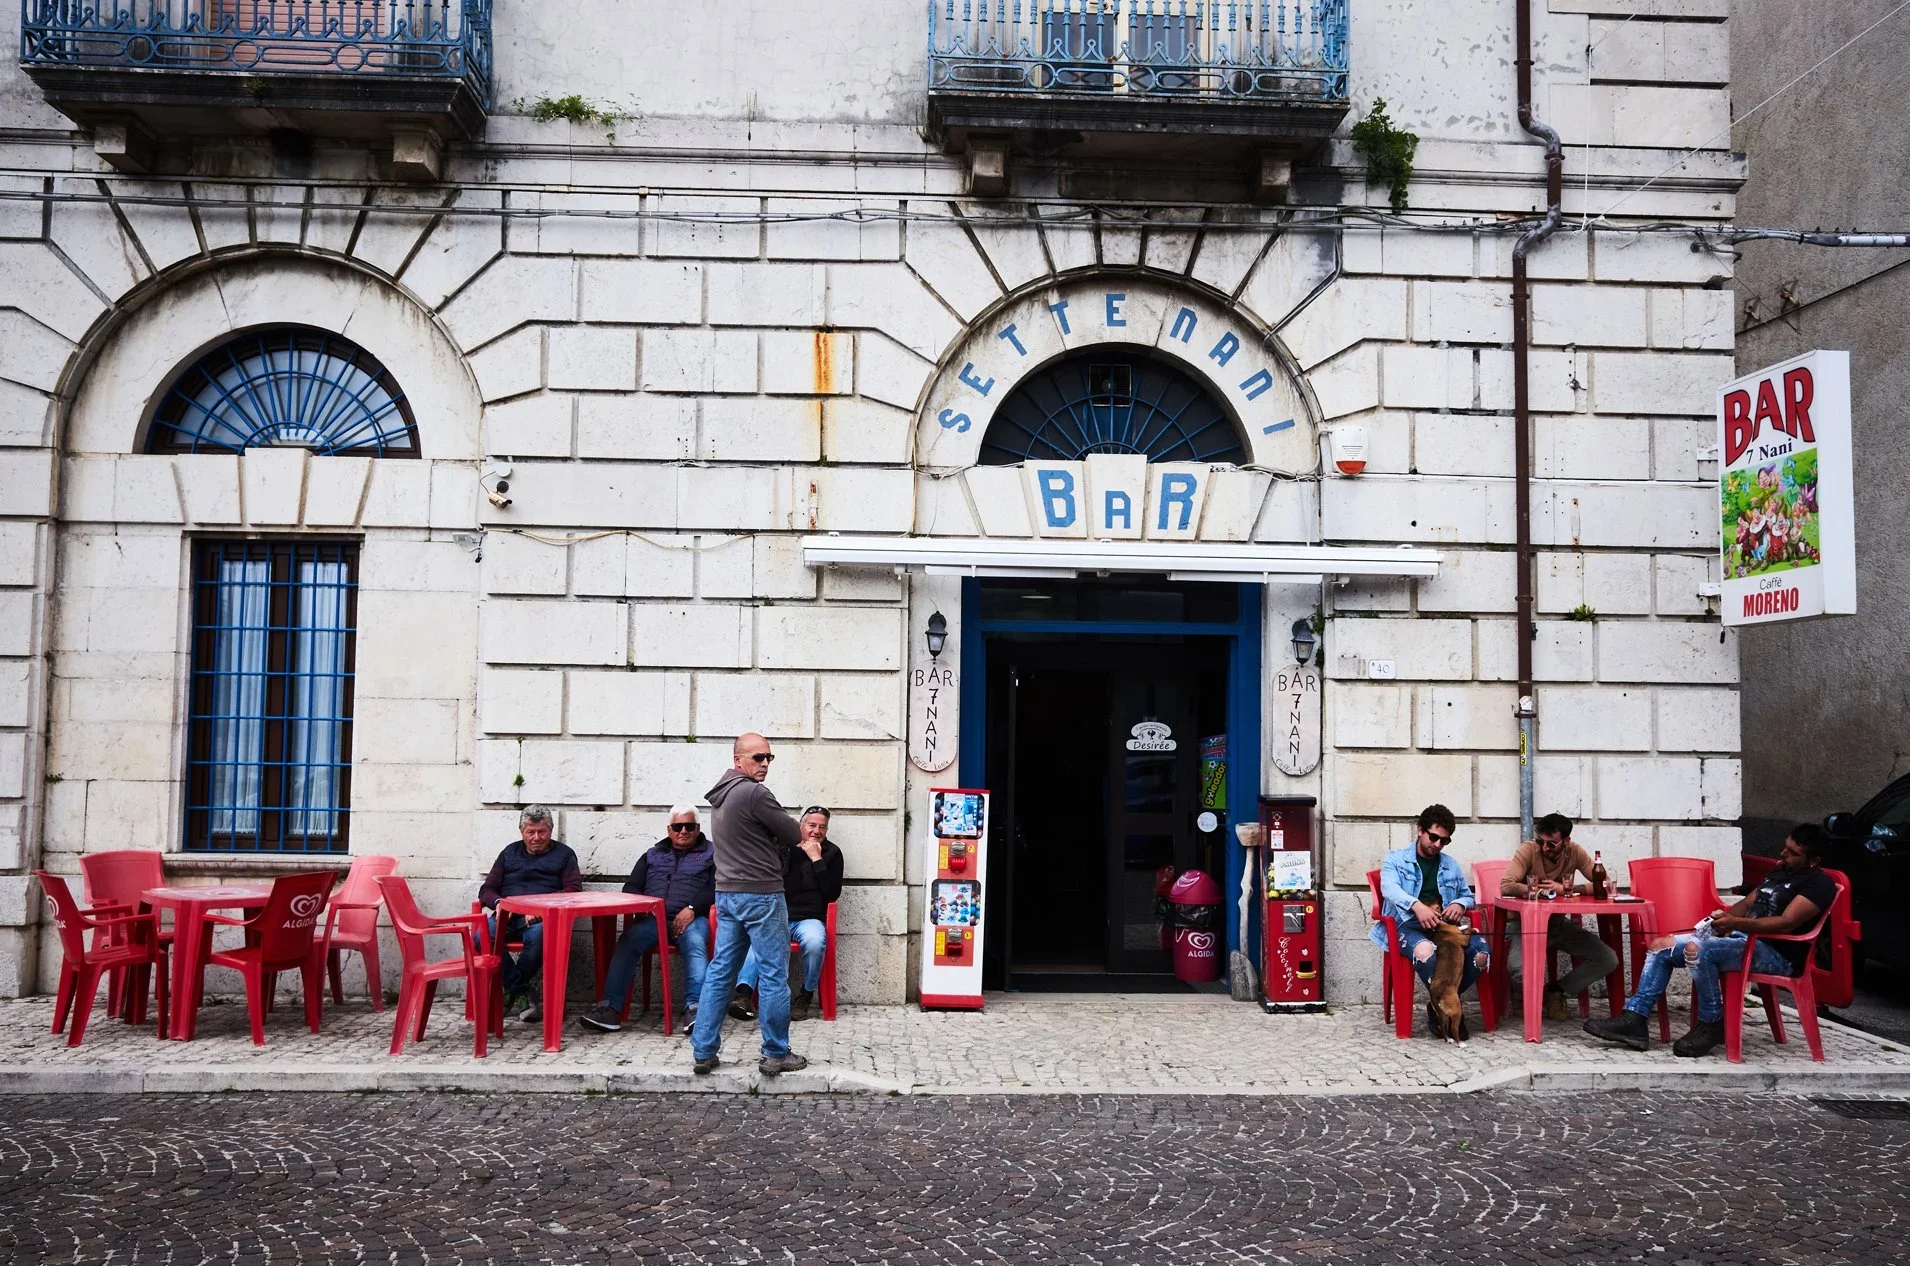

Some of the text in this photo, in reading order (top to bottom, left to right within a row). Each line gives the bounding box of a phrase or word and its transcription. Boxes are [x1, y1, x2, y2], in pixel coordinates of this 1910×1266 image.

[938, 293, 1295, 435] SETTE NANI
[1724, 366, 1816, 468] BAR
[1746, 438, 1793, 464] 7 Nani
[1037, 469, 1198, 531] BAR
[1760, 576, 1782, 590] Caffè
[1743, 586, 1799, 617] MORENO
[915, 666, 954, 687] BAR
[1377, 664, 1390, 674] 40
[1278, 672, 1317, 692] BAR
[1133, 740, 1170, 750] Desirée
